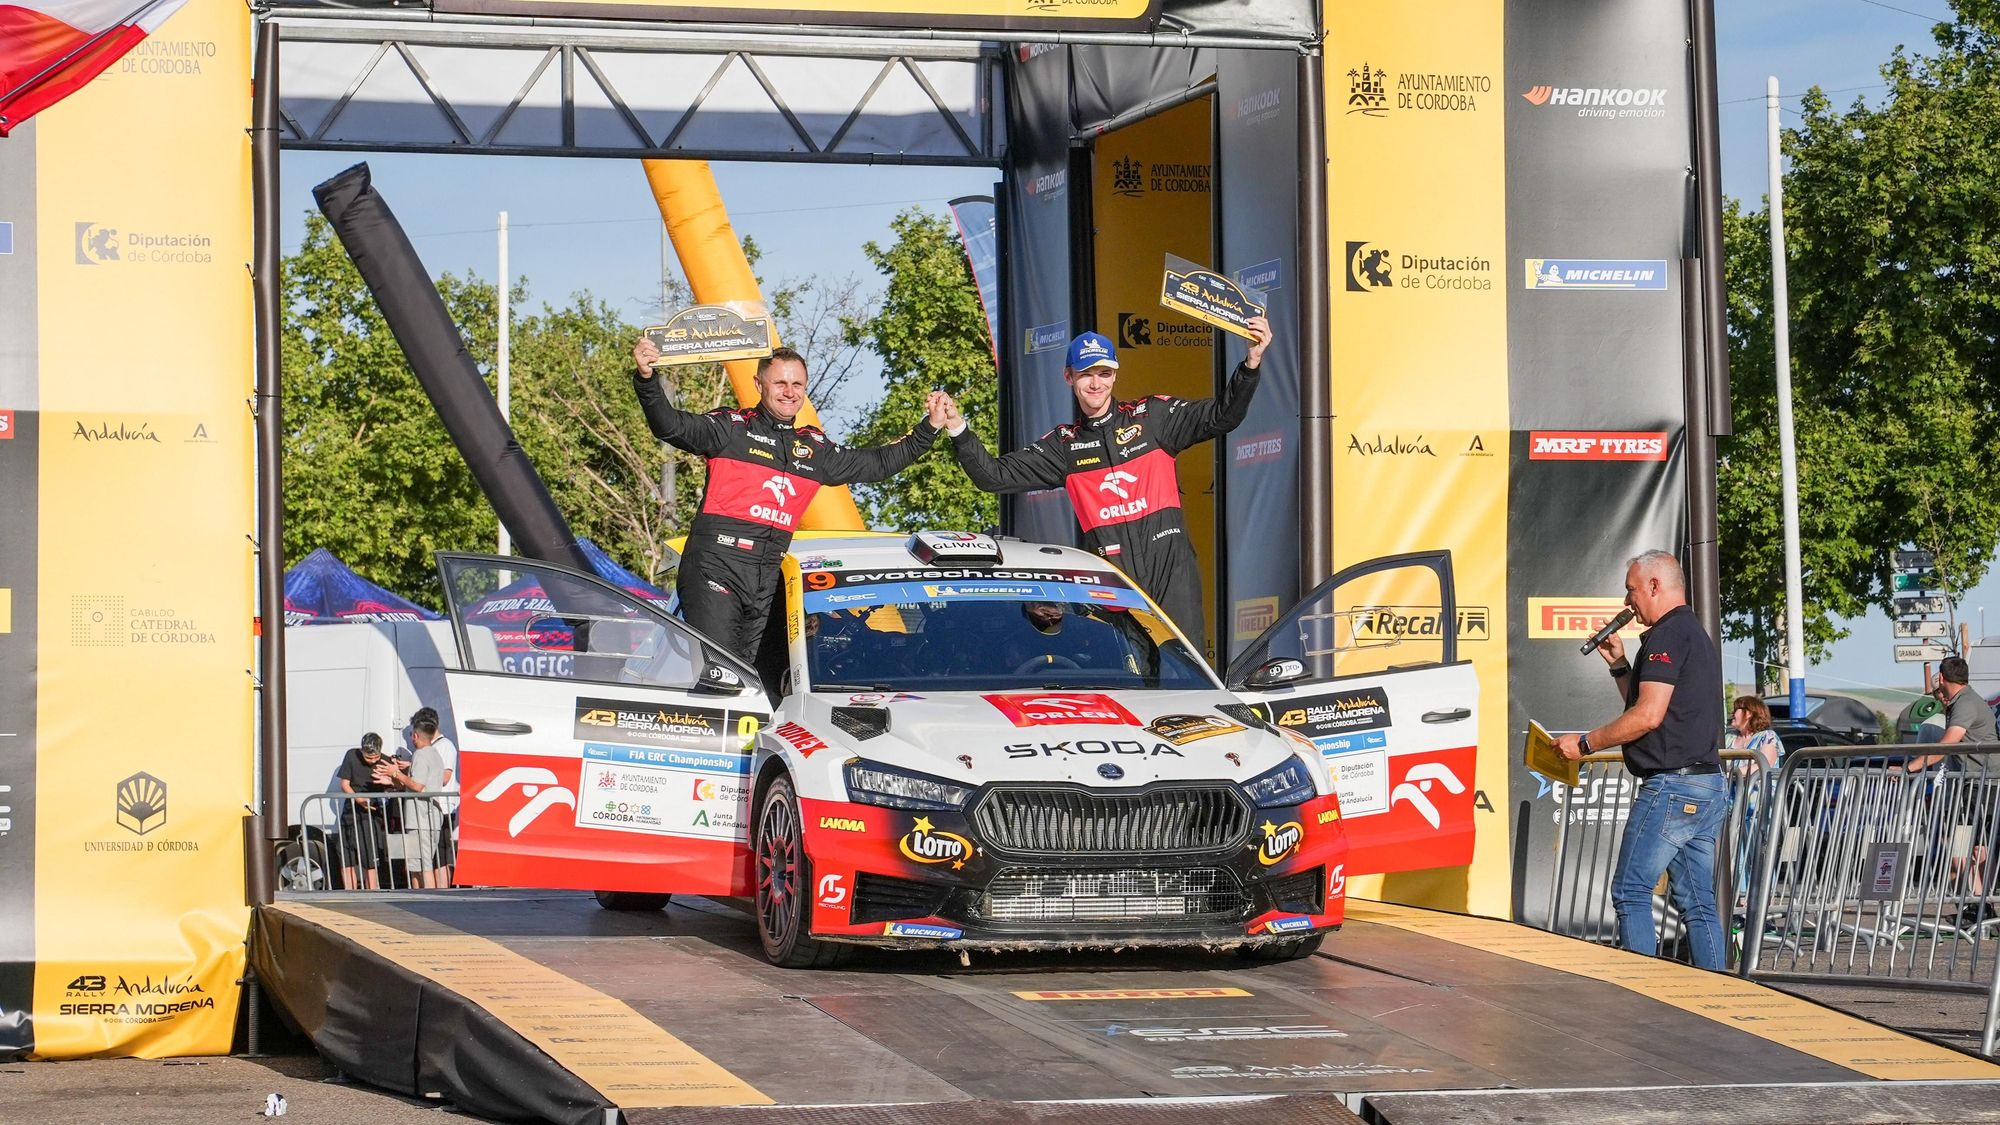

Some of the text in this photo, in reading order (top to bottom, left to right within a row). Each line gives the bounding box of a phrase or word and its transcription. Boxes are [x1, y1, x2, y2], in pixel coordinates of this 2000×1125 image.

[128, 41, 216, 57] UNTAMIENTO
[122, 58, 202, 75] DE CORDOBA
[1397, 74, 1491, 93] AYUNTAMIENTO
[1398, 93, 1476, 111] DE CORDOBA
[1578, 106, 1665, 120] driving emotion
[1151, 164, 1211, 178] AYUNTAMIEN
[1151, 178, 1211, 193] DE CORDOBA
[128, 233, 211, 249] Diputación
[128, 249, 212, 263] de Córdoba
[1401, 254, 1491, 274] Diputación
[1246, 270, 1277, 287] MICHELIN
[1400, 274, 1492, 291] de Córdoba
[1565, 269, 1655, 282] MICHELIN
[1176, 291, 1209, 310] SIERRA
[1210, 305, 1250, 326] MORENA
[662, 342, 703, 352] SIERRA
[705, 338, 754, 349] MORENA
[1157, 335, 1213, 347] de Córdob
[73, 421, 162, 443] Andalucía
[1120, 427, 1138, 442] LOTTO
[1237, 438, 1282, 461] MRF TYRES
[1347, 434, 1437, 457] Andalucía
[1534, 438, 1662, 454] MRF TYRES
[748, 447, 775, 460] LAKMA
[1076, 456, 1101, 466] LAKMA
[750, 505, 793, 527] ORLEN
[1099, 498, 1148, 520] ORLEN
[717, 536, 736, 545] OMP
[1157, 528, 1181, 539] MATULKA
[932, 541, 996, 551] GLIWICE
[808, 571, 836, 590] 9
[845, 569, 1101, 585] evotech.com.pl
[131, 609, 175, 618] CABILDO
[1236, 604, 1275, 633] PIRELLI
[131, 620, 197, 631] CATEDRAL
[1376, 612, 1464, 635] Recali
[131, 630, 216, 644] DE CÓRDOBA
[1025, 710, 1119, 721] ORLEN
[1278, 695, 1379, 727] 43 RALLY Andalucía
[1307, 706, 1386, 724] SIERRA MORENA
[580, 710, 759, 749] 43 RALLY Andalucía 9
[617, 720, 717, 737] SIERRA MORENA
[1332, 718, 1357, 729] CÓRDOBA
[648, 731, 680, 742] CÓRDOBA
[1316, 739, 1351, 751] pionship
[629, 750, 645, 760] FIA
[648, 751, 666, 762] ERC
[668, 753, 734, 770] Championship
[1341, 761, 1374, 773] Diputación
[621, 773, 667, 785] AYUNTAMIENTO
[1341, 769, 1375, 781] de Córdoba
[629, 782, 658, 794] CÓRDOBA
[720, 785, 749, 795] Diputac
[731, 793, 749, 802] Córd
[1347, 794, 1373, 805] Andalucía
[592, 811, 634, 822] CÓRDOBA
[713, 812, 733, 820] Junta
[1317, 809, 1339, 824] LAKMA
[723, 820, 748, 829] Andalu
[819, 816, 866, 833] LAKMA
[84, 839, 199, 852] UNIVERSIDAD CÓRDOBA
[913, 832, 961, 857] LOTTO
[1268, 827, 1298, 856] LOTTO
[818, 902, 846, 911] RECYCLING
[1281, 920, 1309, 929] MICHELIN
[904, 928, 955, 938] MICHELIN
[67, 975, 206, 996] 43 Andalucía
[60, 997, 215, 1016] SIERRA MORENA
[125, 1016, 157, 1024] CÓRDOBA
